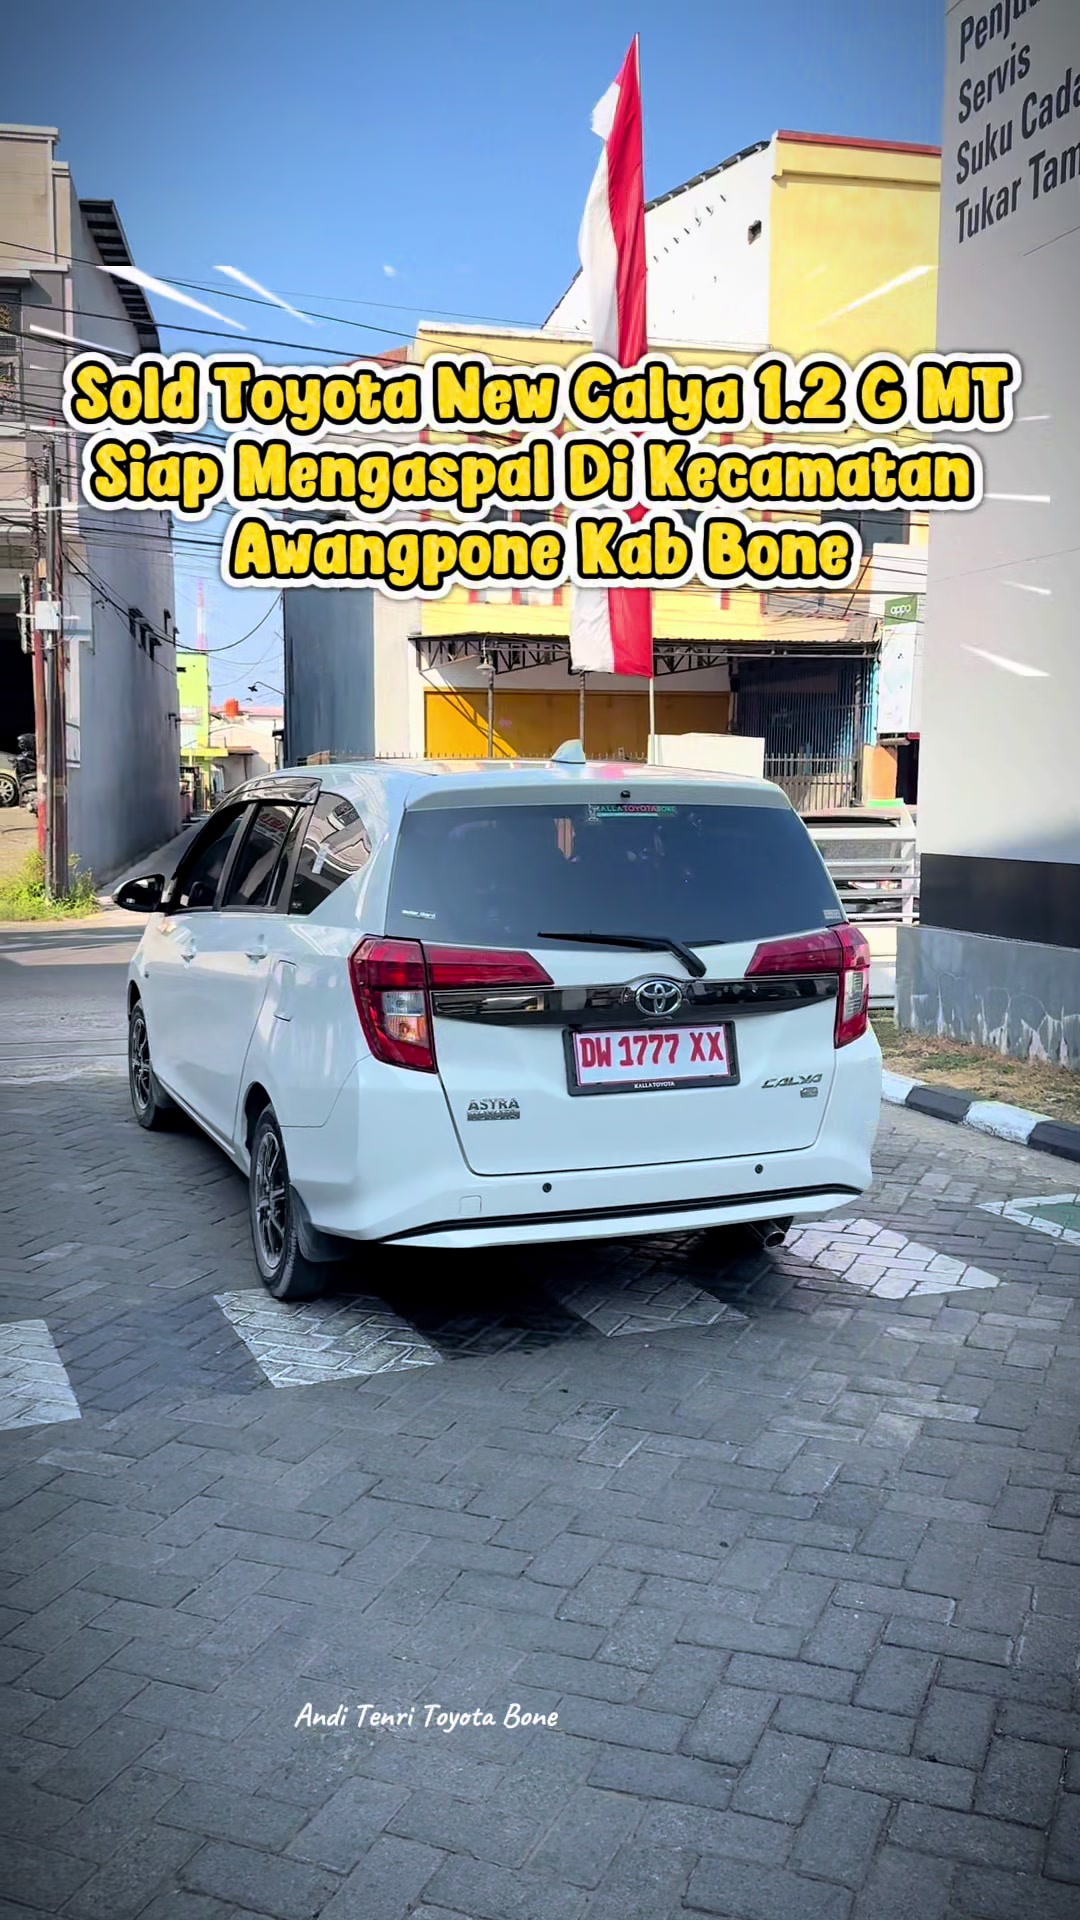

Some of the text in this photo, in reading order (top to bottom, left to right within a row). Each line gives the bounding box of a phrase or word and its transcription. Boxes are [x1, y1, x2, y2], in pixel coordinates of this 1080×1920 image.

[960, 0, 1040, 64] Penju
[958, 42, 1031, 124] Servis
[956, 119, 1013, 185] Suku
[955, 177, 1022, 244] Tukar
[580, 1031, 724, 1068] DW 1777 XX
[761, 1073, 823, 1088] CALYA
[468, 1098, 520, 1110] ASTRA
